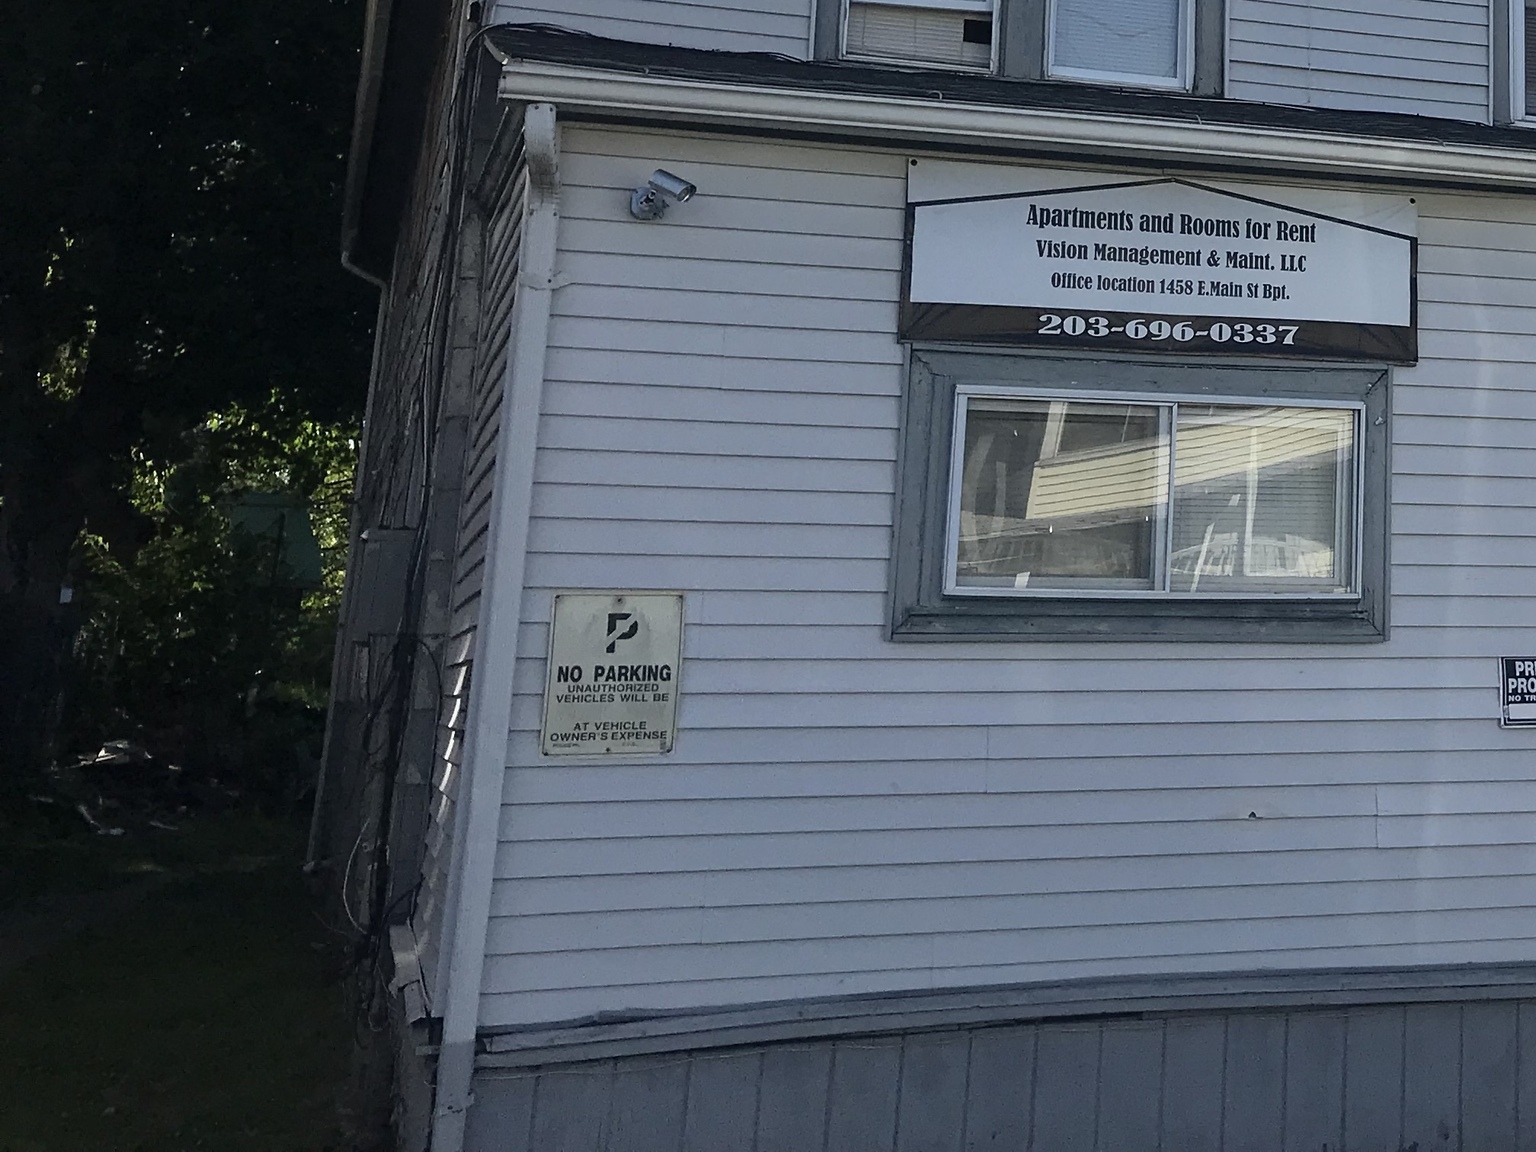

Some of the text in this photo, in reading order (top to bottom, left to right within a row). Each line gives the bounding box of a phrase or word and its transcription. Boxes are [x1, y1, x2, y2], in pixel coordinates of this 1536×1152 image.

[1026, 204, 1317, 243] Apartments and Rooms for Rent
[1036, 239, 1307, 272] Vision Management & Maint. LLC
[1051, 272, 1093, 290] Office
[1097, 275, 1155, 293] location
[1159, 279, 1194, 295] 1458
[1247, 283, 1259, 298] St
[1262, 284, 1290, 301] Bpt.
[1037, 313, 1300, 345] 203-696-0337
[557, 664, 671, 683] NO PARKING
[567, 683, 660, 693] UNAUTHORIZED
[556, 693, 670, 703] VEHICLES WILL BE
[1508, 694, 1522, 702] NO
[573, 721, 647, 731] AT VEHICLE
[550, 730, 667, 742] OWNER'S EXPENSE
